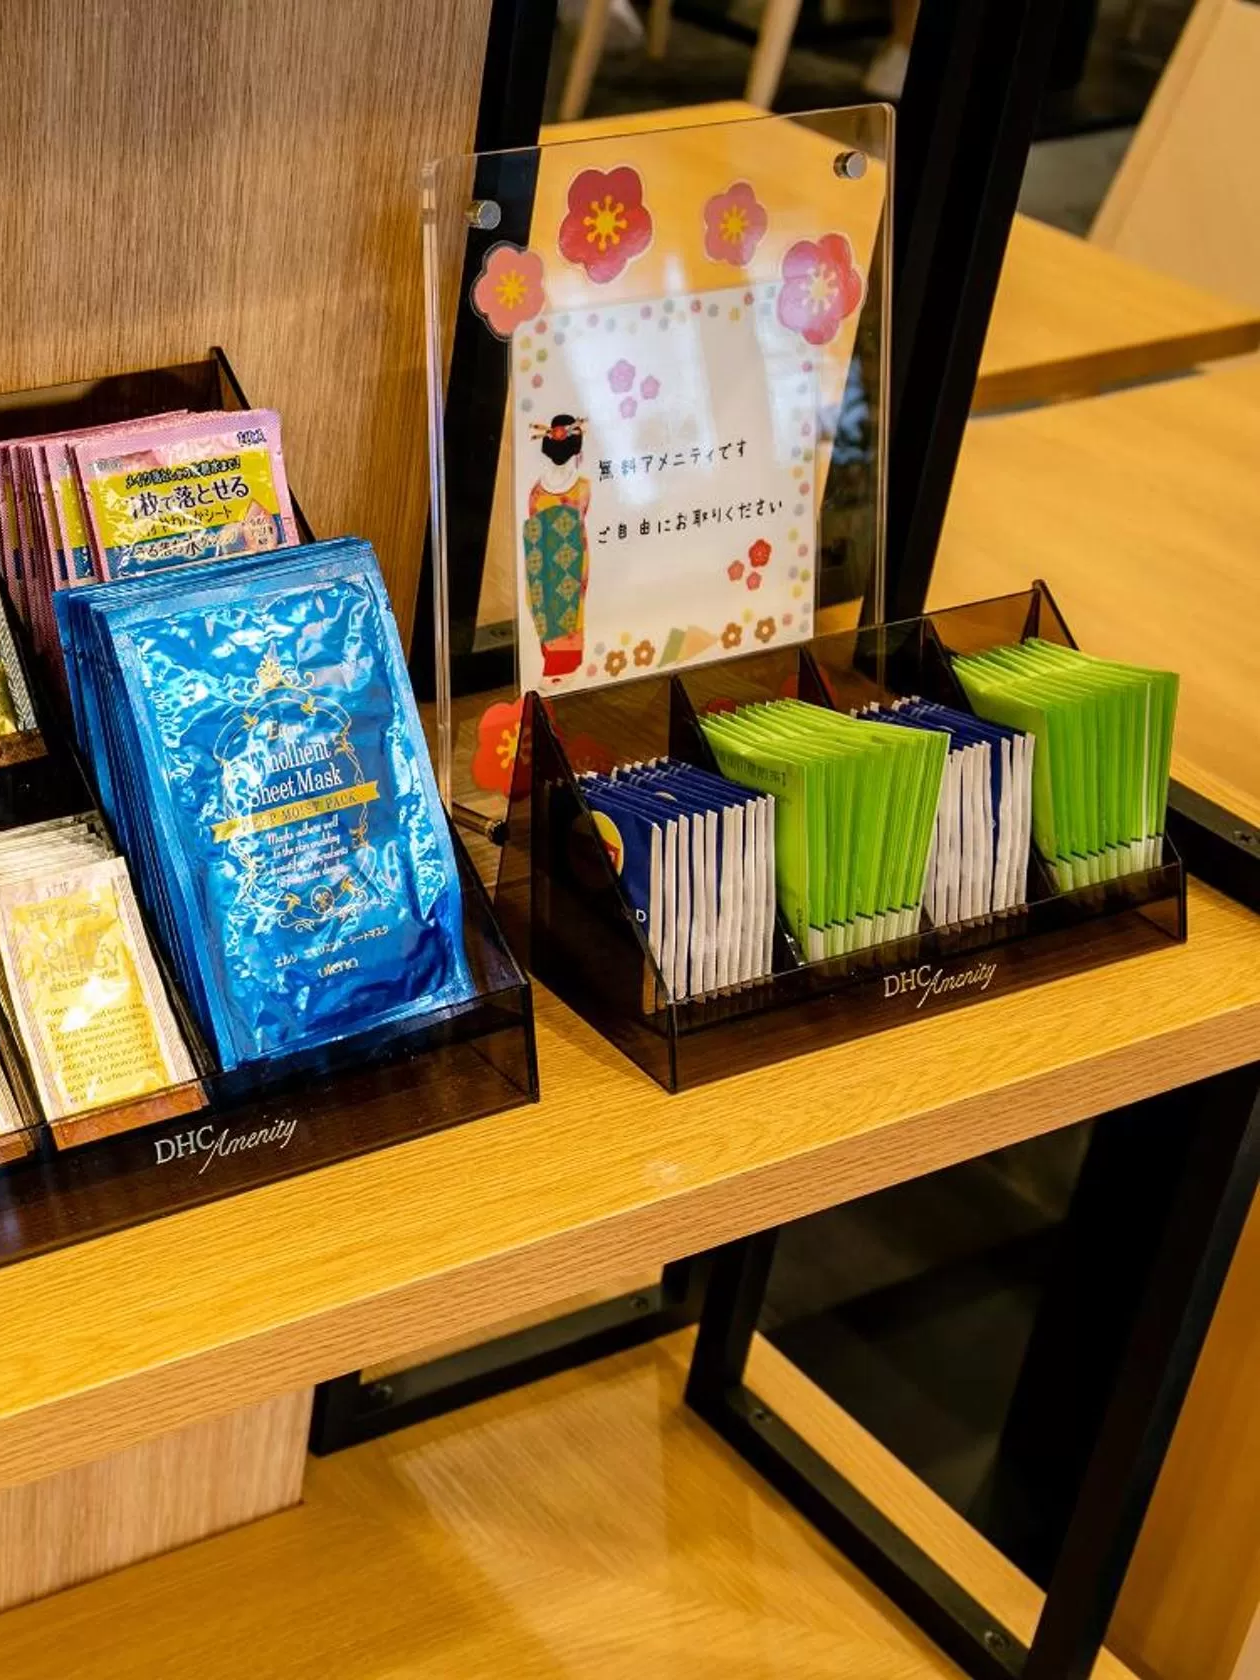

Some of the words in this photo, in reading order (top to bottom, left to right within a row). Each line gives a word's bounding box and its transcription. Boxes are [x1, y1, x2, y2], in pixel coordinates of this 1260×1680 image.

[599, 439, 746, 482] 無料アメニティです
[598, 499, 782, 544] ご自由にお取りください
[296, 762, 342, 795] Mask
[283, 801, 320, 820] MOIST
[325, 791, 356, 808] PACK
[883, 965, 931, 998] DHC
[917, 962, 997, 1008] Amenity
[154, 1124, 215, 1165] DHC
[199, 1120, 297, 1175] Amenity
